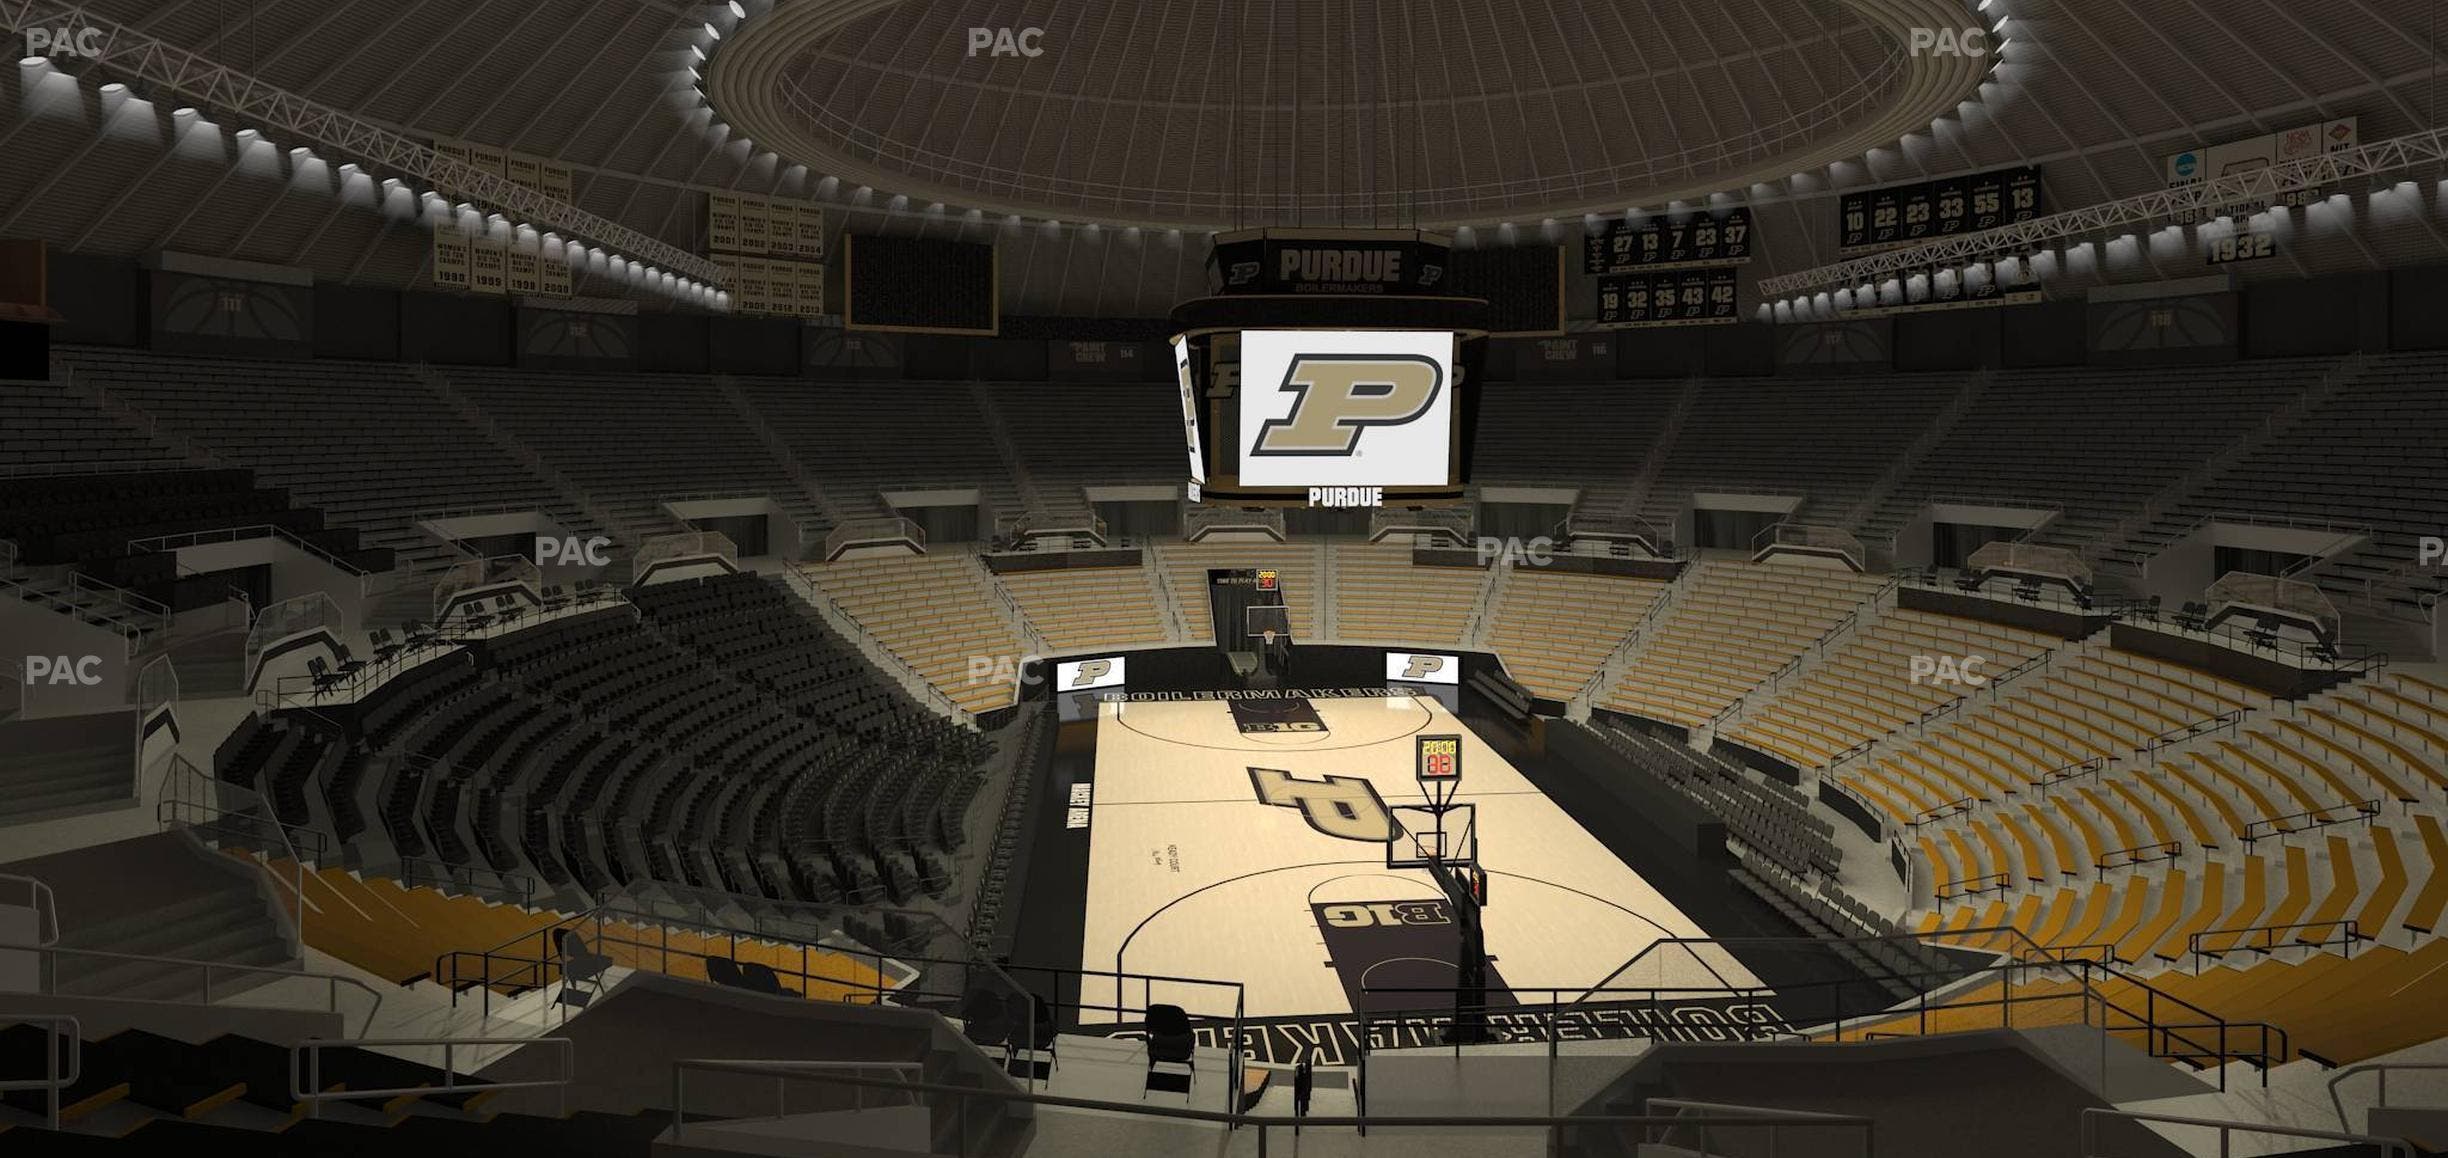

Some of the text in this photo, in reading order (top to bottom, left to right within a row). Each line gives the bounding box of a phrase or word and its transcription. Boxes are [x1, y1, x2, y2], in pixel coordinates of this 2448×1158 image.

[1974, 193, 2000, 215] 55
[2011, 187, 2035, 210] 13
[1874, 207, 1898, 229] 22
[1906, 202, 1930, 224] 23
[1939, 198, 1964, 220] 33
[1846, 211, 1864, 232] 10
[1613, 235, 1634, 253] 27
[1642, 233, 1659, 251] 13
[1672, 230, 1684, 248] 7
[1696, 227, 1718, 246] 23
[1724, 225, 1747, 243] 37
[2209, 234, 2274, 263] 1932
[1280, 249, 1400, 282] PURDUE
[1295, 283, 1384, 294] BOILERMAKERS
[1654, 288, 1676, 306] 35
[1681, 286, 1705, 305] 43
[1711, 285, 1734, 304] 42
[1602, 293, 1619, 310] 19
[1627, 290, 1648, 308] 32
[1250, 353, 1443, 456] P
[1309, 487, 1382, 507] PURDUE
[1072, 660, 1111, 687] P
[1402, 656, 1443, 678] P
[1104, 687, 1417, 702] BOILERMAKERS
[1246, 766, 1403, 843] P
[1104, 1003, 1797, 1066] BOILERAKE
